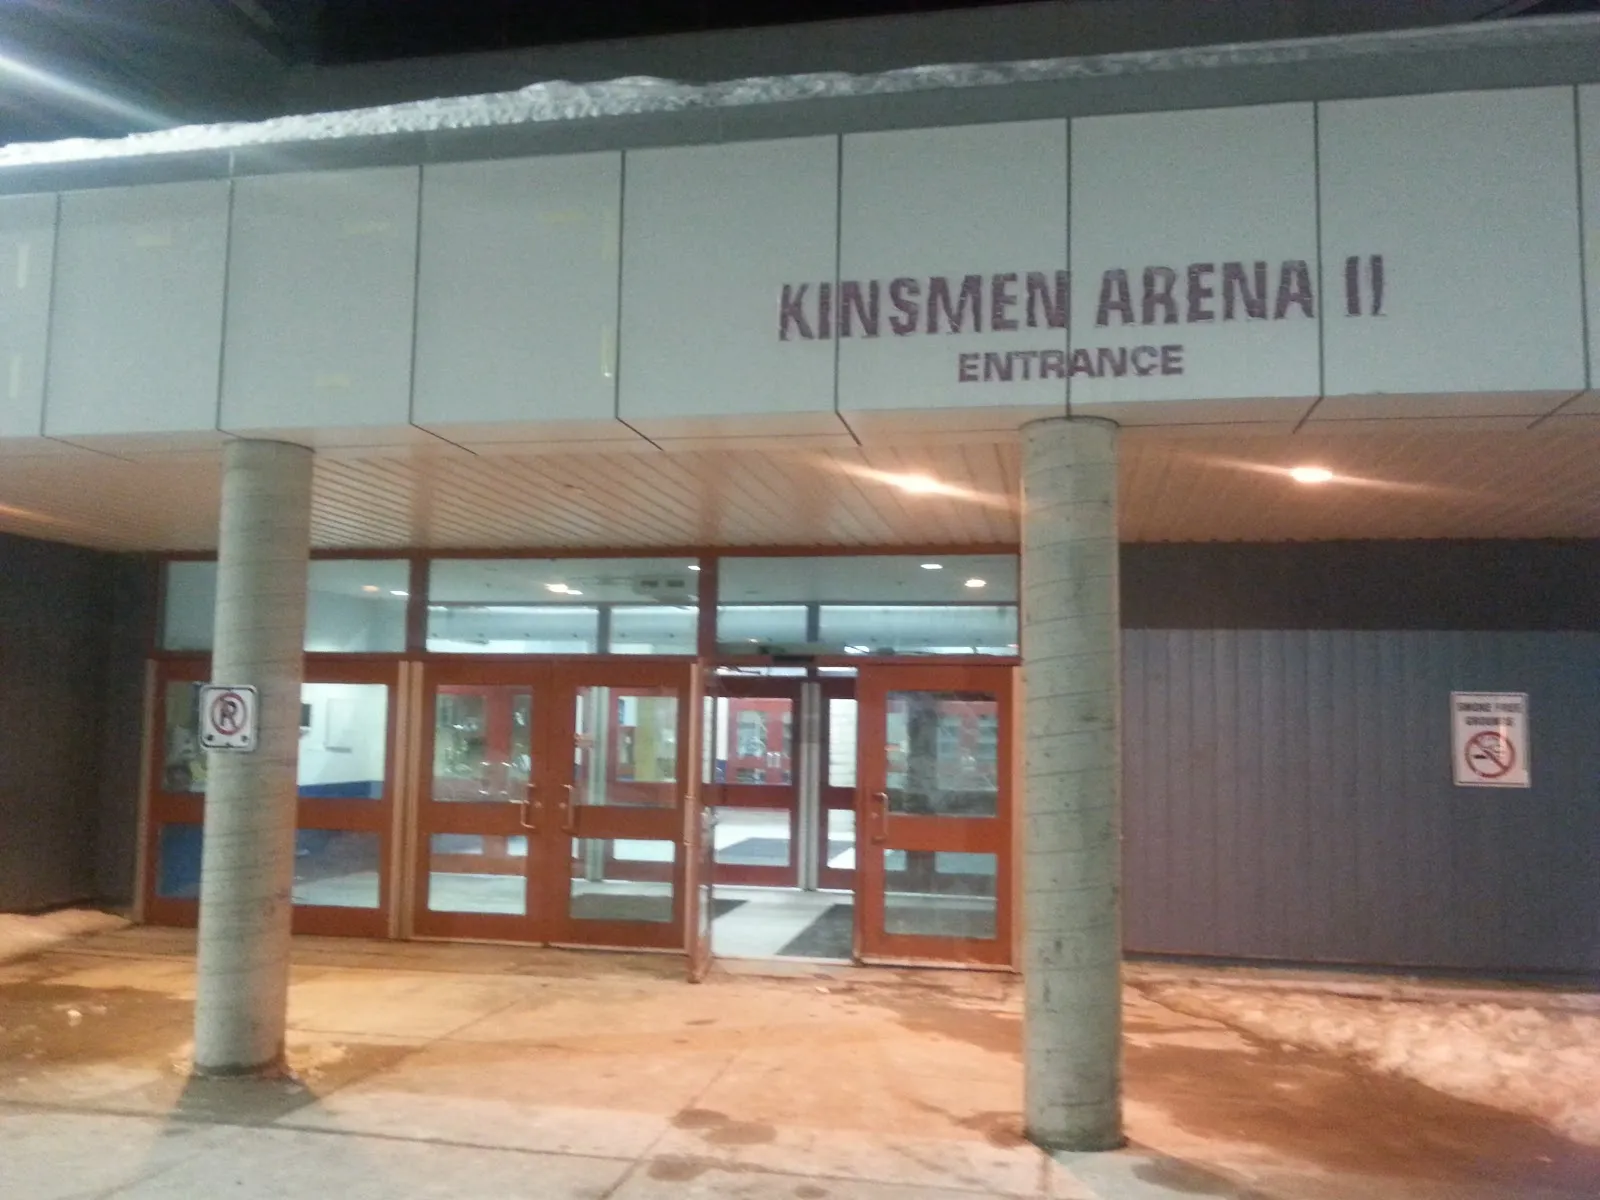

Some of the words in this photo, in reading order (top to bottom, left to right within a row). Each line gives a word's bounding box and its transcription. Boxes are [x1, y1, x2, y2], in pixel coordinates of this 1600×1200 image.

[778, 269, 1070, 342] KINSMEN
[1095, 258, 1318, 328] ARENA
[958, 344, 1185, 384] ENTRANCE
